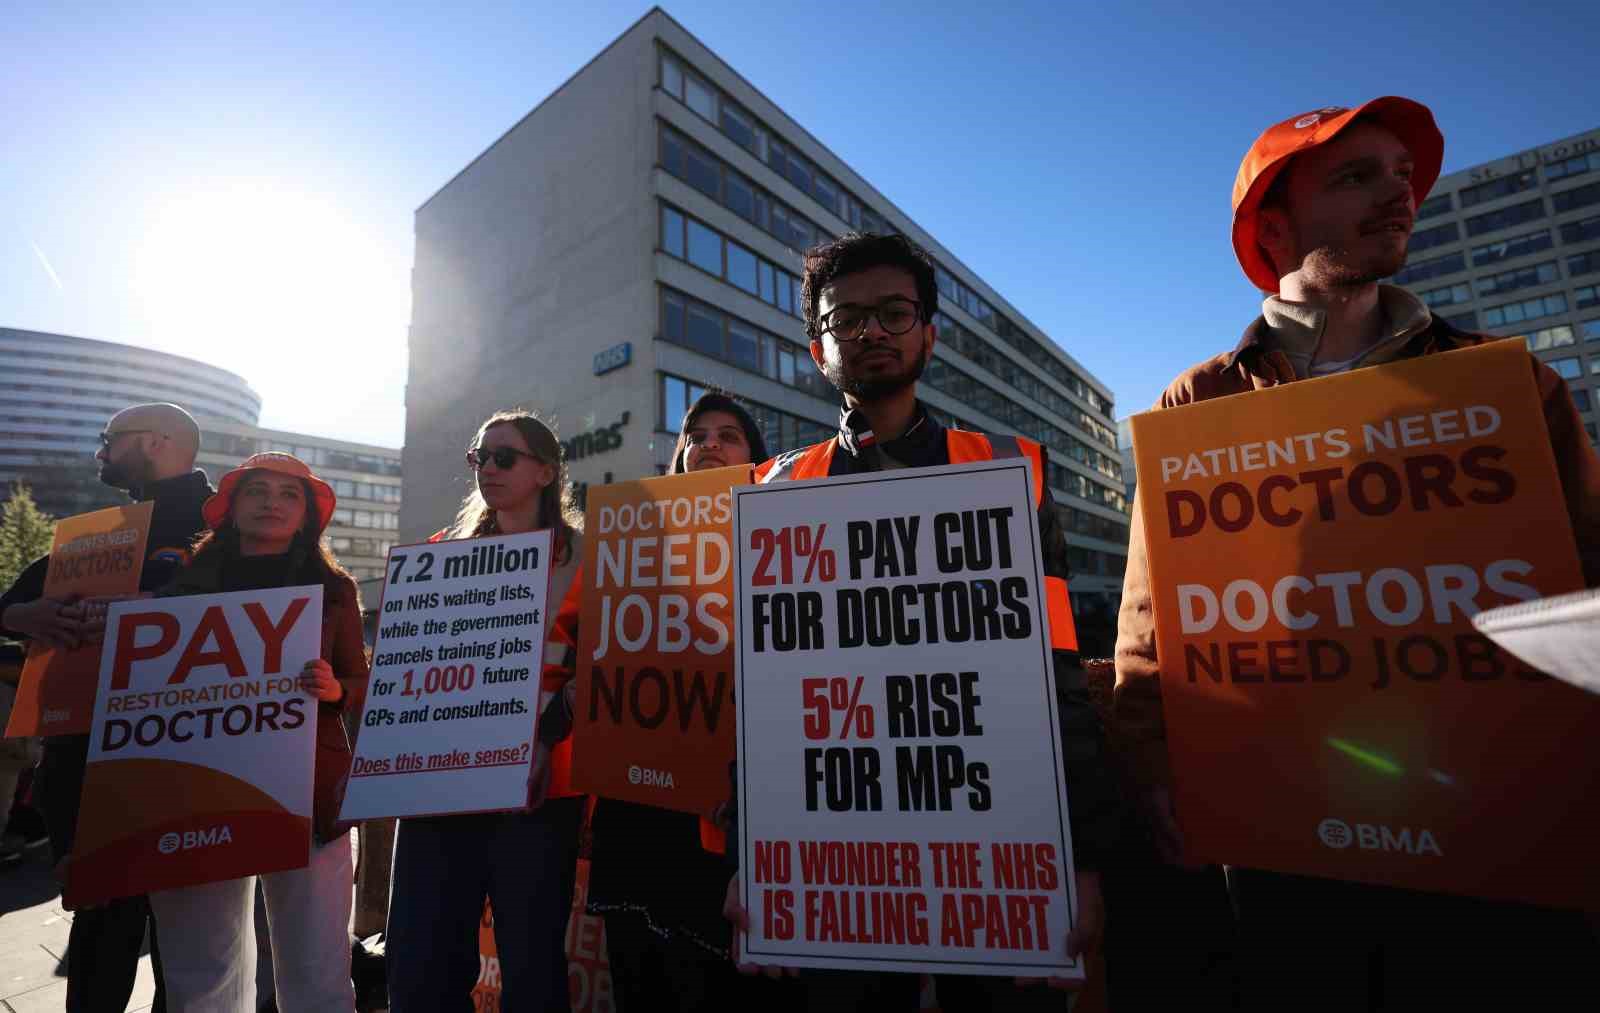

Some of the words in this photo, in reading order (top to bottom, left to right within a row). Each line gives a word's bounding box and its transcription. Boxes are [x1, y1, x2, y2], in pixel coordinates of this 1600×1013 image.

[1161, 427, 1350, 483] PATIENTS
[1363, 405, 1500, 454] NEED
[599, 492, 731, 533] DOCTORS
[1166, 446, 1518, 539] DOCTORS
[50, 547, 135, 581] DOCTORS
[390, 552, 434, 584] 7.2
[443, 544, 539, 579] million
[596, 532, 731, 588] NEED
[751, 524, 836, 587] 21%
[847, 515, 921, 580] PAY
[934, 507, 1014, 574] CUT
[384, 599, 402, 613] on
[407, 592, 439, 610] NHS
[444, 587, 496, 606] waiting
[500, 584, 534, 601] lists,
[752, 592, 825, 652] FOR
[838, 577, 1032, 649] DOCTORS
[110, 597, 311, 690] PAY
[381, 621, 418, 639] while
[424, 619, 447, 635] the
[451, 609, 540, 636] government
[593, 592, 729, 660] JOBS
[376, 646, 433, 666] cancels
[438, 641, 496, 661] training
[499, 637, 532, 658] jobs
[1184, 637, 1352, 685] NEED
[107, 680, 260, 714] RESTORATION
[373, 679, 396, 696] for
[400, 664, 475, 700] 1,000
[483, 667, 529, 685] future
[589, 666, 727, 736] NOW
[802, 677, 874, 740] 5%
[885, 672, 983, 738] RISE
[102, 698, 306, 752] DOCTORS
[365, 709, 394, 727] GPs
[399, 705, 430, 724] and
[433, 698, 528, 721] consultants.
[353, 756, 390, 774] Does
[395, 753, 423, 771] this
[427, 749, 470, 768] make
[475, 743, 530, 764] sense?
[643, 768, 674, 789] BMA
[804, 747, 881, 812] FOR
[895, 745, 992, 812] MPs
[183, 825, 233, 849] BMA
[1357, 823, 1442, 857] BMA
[754, 841, 792, 884] NO
[799, 841, 921, 887] WONDER
[928, 842, 982, 889] THE
[991, 843, 1058, 890] NHS
[763, 890, 795, 941] IS
[805, 890, 929, 946] FALLING
[941, 894, 1050, 951] APART
